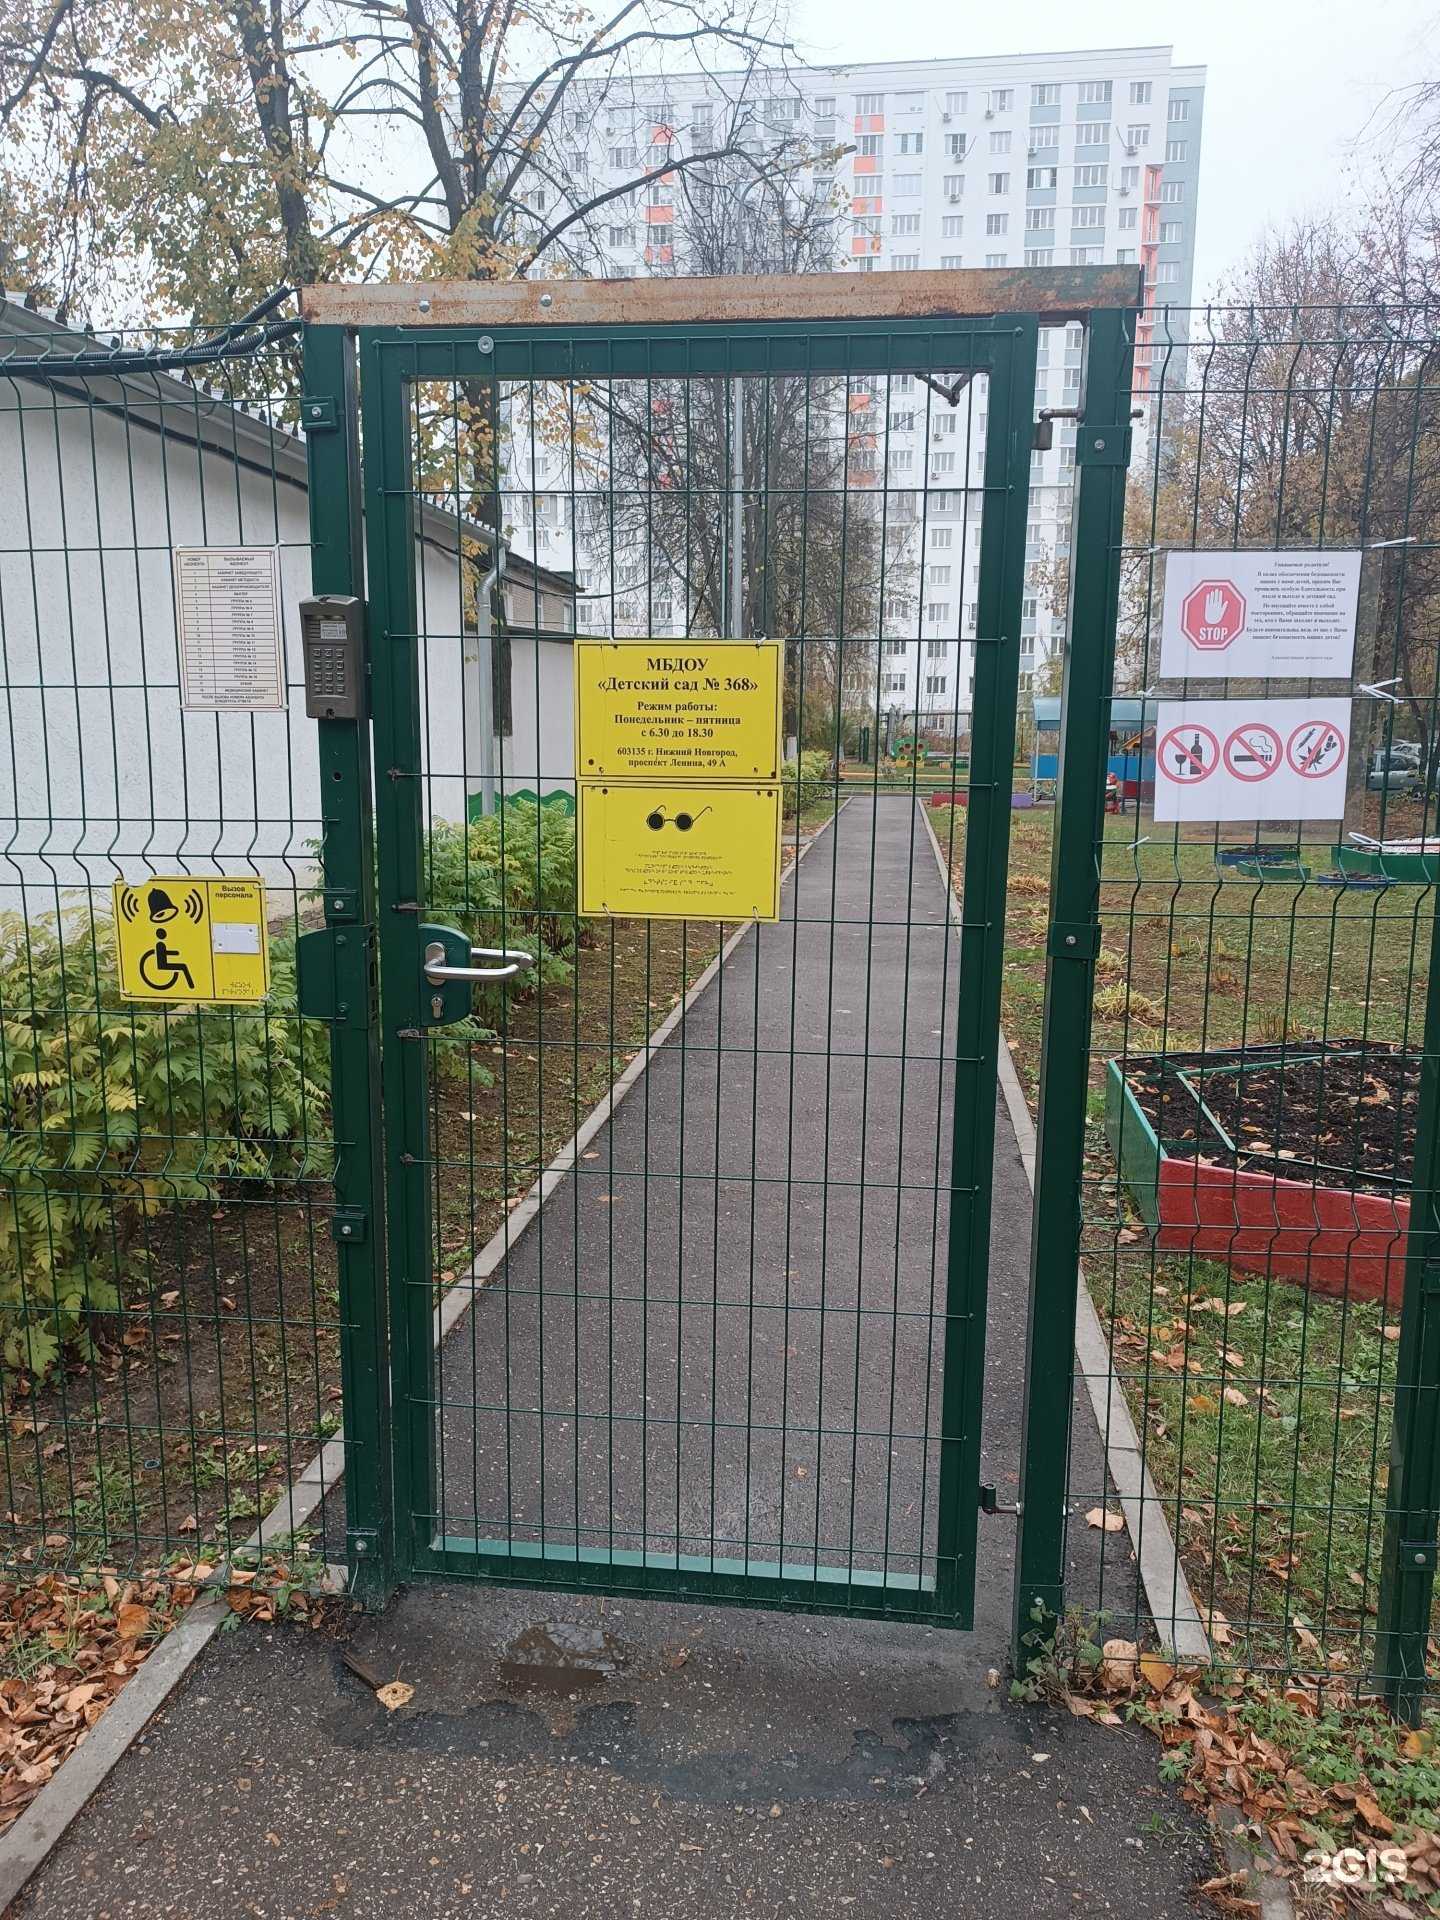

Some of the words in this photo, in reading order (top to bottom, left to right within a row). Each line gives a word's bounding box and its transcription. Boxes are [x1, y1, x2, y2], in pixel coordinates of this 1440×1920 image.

[1199, 627, 1228, 640] STOP
[646, 658, 709, 674] МБДОУ
[598, 677, 669, 691] «Детский
[674, 680, 698, 691] сад
[703, 678, 720, 691] №
[724, 678, 758, 691] 368»
[637, 701, 673, 711] Режим
[675, 702, 718, 713] работы:
[614, 715, 684, 726] Понедельник
[696, 717, 740, 726] пятница
[649, 728, 669, 737] 6.30
[672, 730, 684, 738] до
[687, 728, 713, 738] 18.30
[617, 748, 646, 756] 603135
[656, 748, 692, 756] Нижний
[694, 748, 737, 758] Новгород,
[628, 760, 667, 768] проспект
[669, 759, 705, 768] Ленина,
[707, 759, 717, 767] 49
